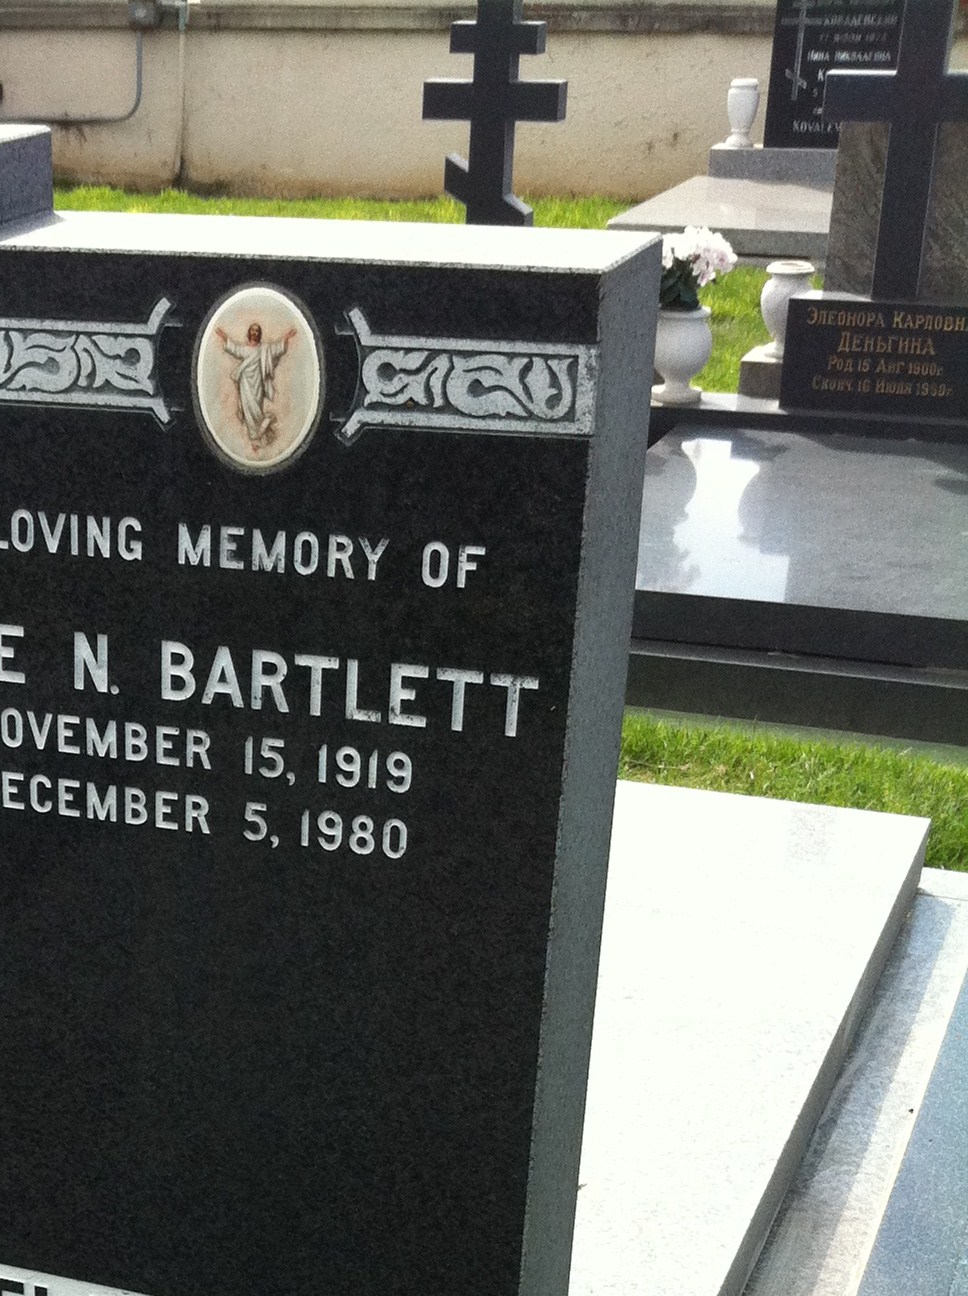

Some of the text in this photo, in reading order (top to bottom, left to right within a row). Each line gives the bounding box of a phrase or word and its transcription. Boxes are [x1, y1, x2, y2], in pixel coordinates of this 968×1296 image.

[837, 331, 936, 355] ДЕНЬГИНА
[893, 310, 968, 332] КАРЛОВН
[177, 523, 390, 581] MEMORY
[421, 540, 487, 589] OF
[73, 631, 121, 696] N.
[160, 639, 540, 738] BARTLETT
[244, 736, 296, 787] 15,
[318, 743, 413, 794] 1919
[243, 801, 280, 849] 5,
[300, 810, 408, 860] 1980
